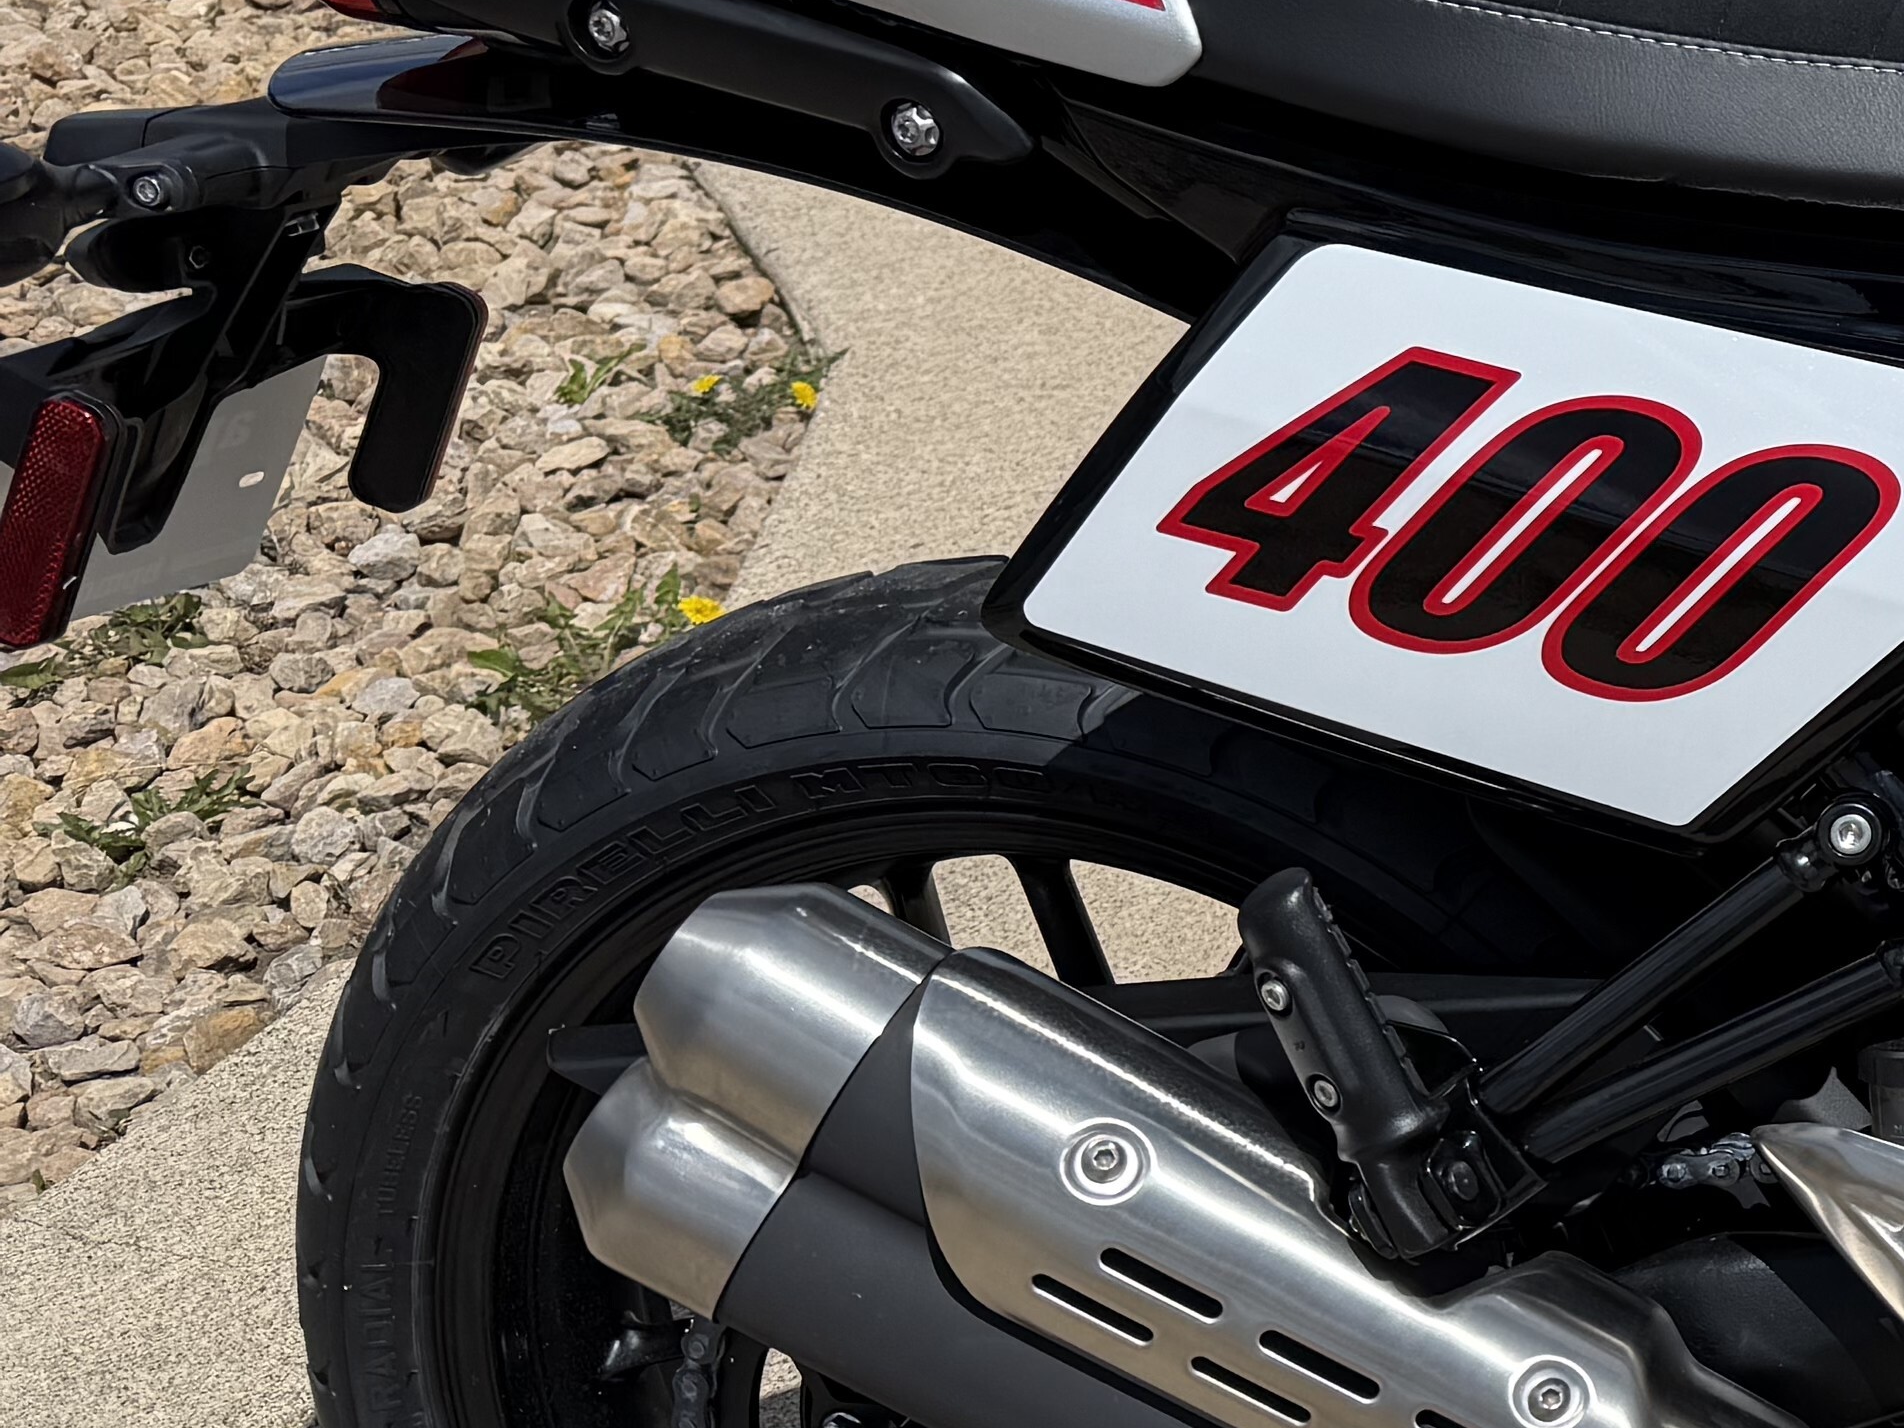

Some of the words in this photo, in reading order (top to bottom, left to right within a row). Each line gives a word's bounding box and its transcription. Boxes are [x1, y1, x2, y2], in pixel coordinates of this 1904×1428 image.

[1156, 346, 1901, 702] 400
[466, 777, 777, 988] PIRELLI
[788, 758, 1051, 802] MT60
[372, 1087, 427, 1219] TUBELESS
[358, 1252, 404, 1413] RADIAL
